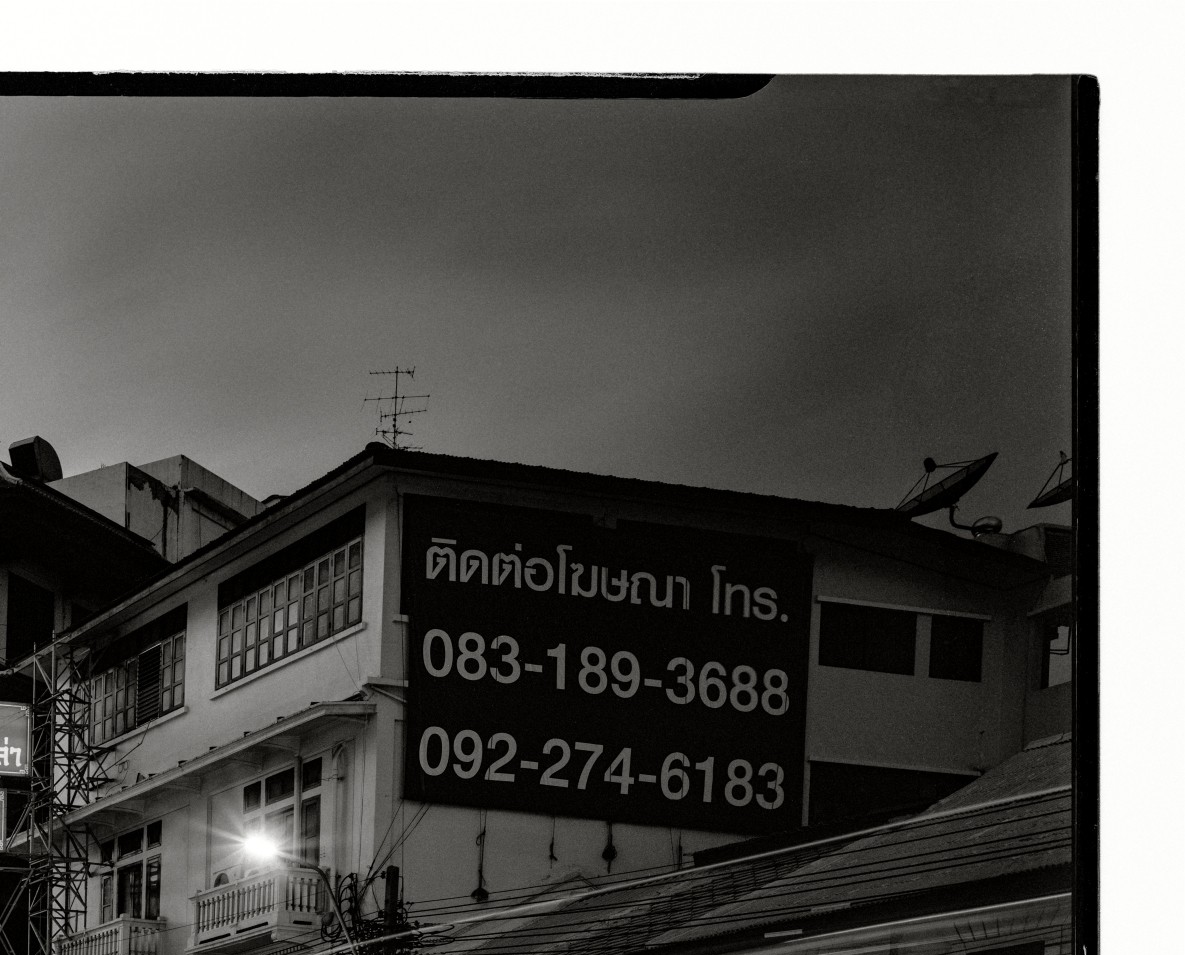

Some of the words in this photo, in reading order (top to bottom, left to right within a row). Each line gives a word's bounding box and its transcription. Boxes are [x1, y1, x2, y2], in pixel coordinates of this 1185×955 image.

[425, 537, 691, 611] ติดต่อโฆษณา
[711, 565, 789, 623] โทร.
[422, 628, 790, 716] 083-189-3688
[418, 726, 786, 810] 092-274-6183
